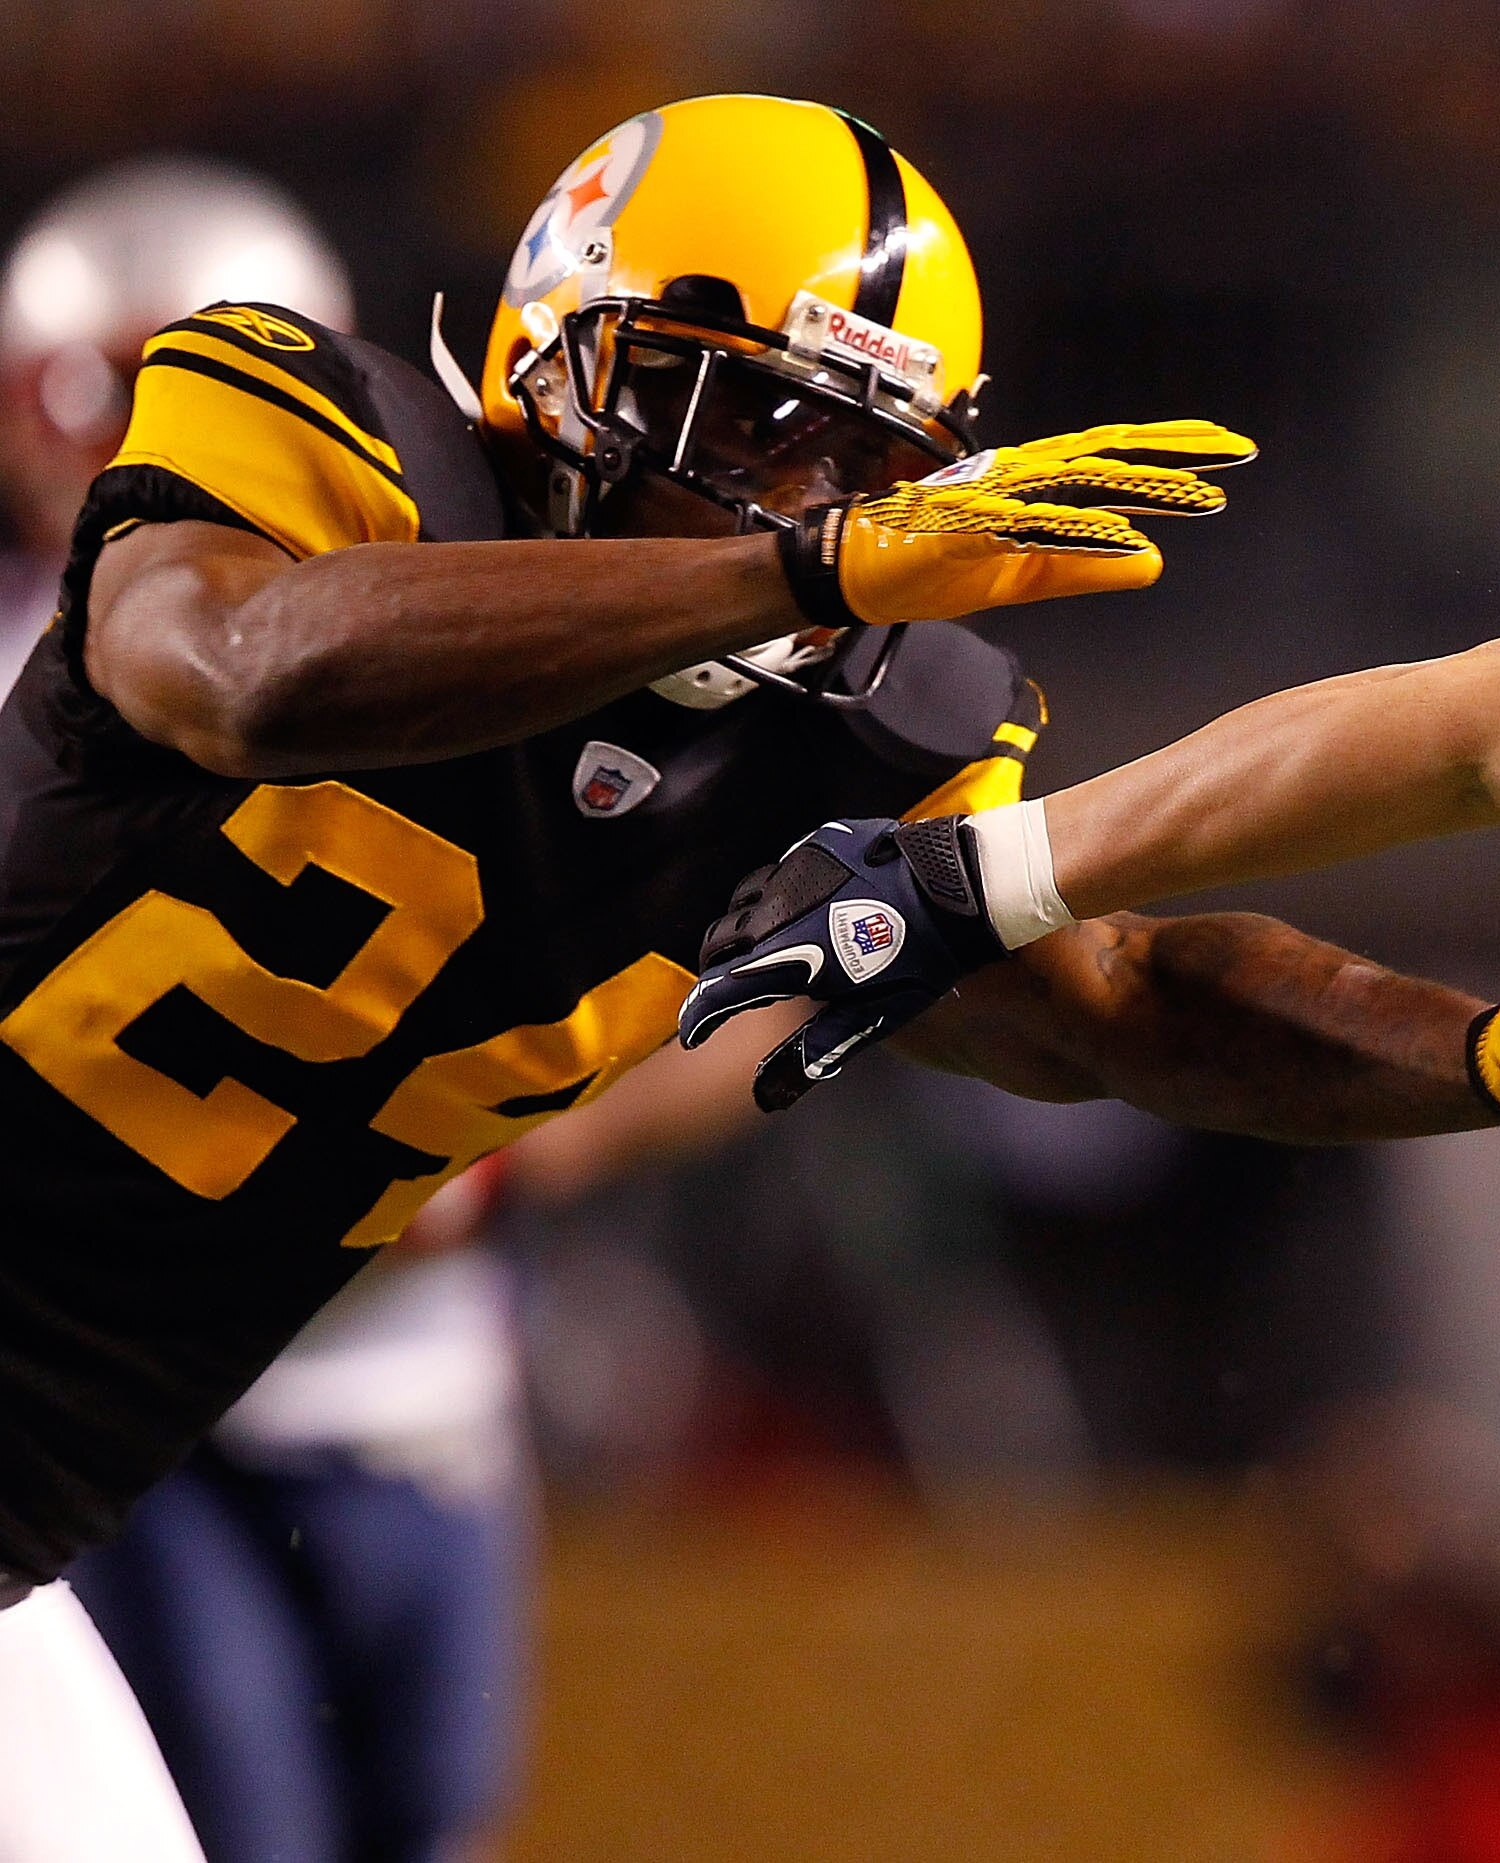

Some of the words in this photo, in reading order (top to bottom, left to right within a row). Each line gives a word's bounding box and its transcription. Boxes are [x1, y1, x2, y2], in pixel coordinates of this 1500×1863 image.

[829, 313, 909, 370] Riddell
[837, 912, 865, 974] EQUIPMENT
[867, 915, 892, 947] NFL
